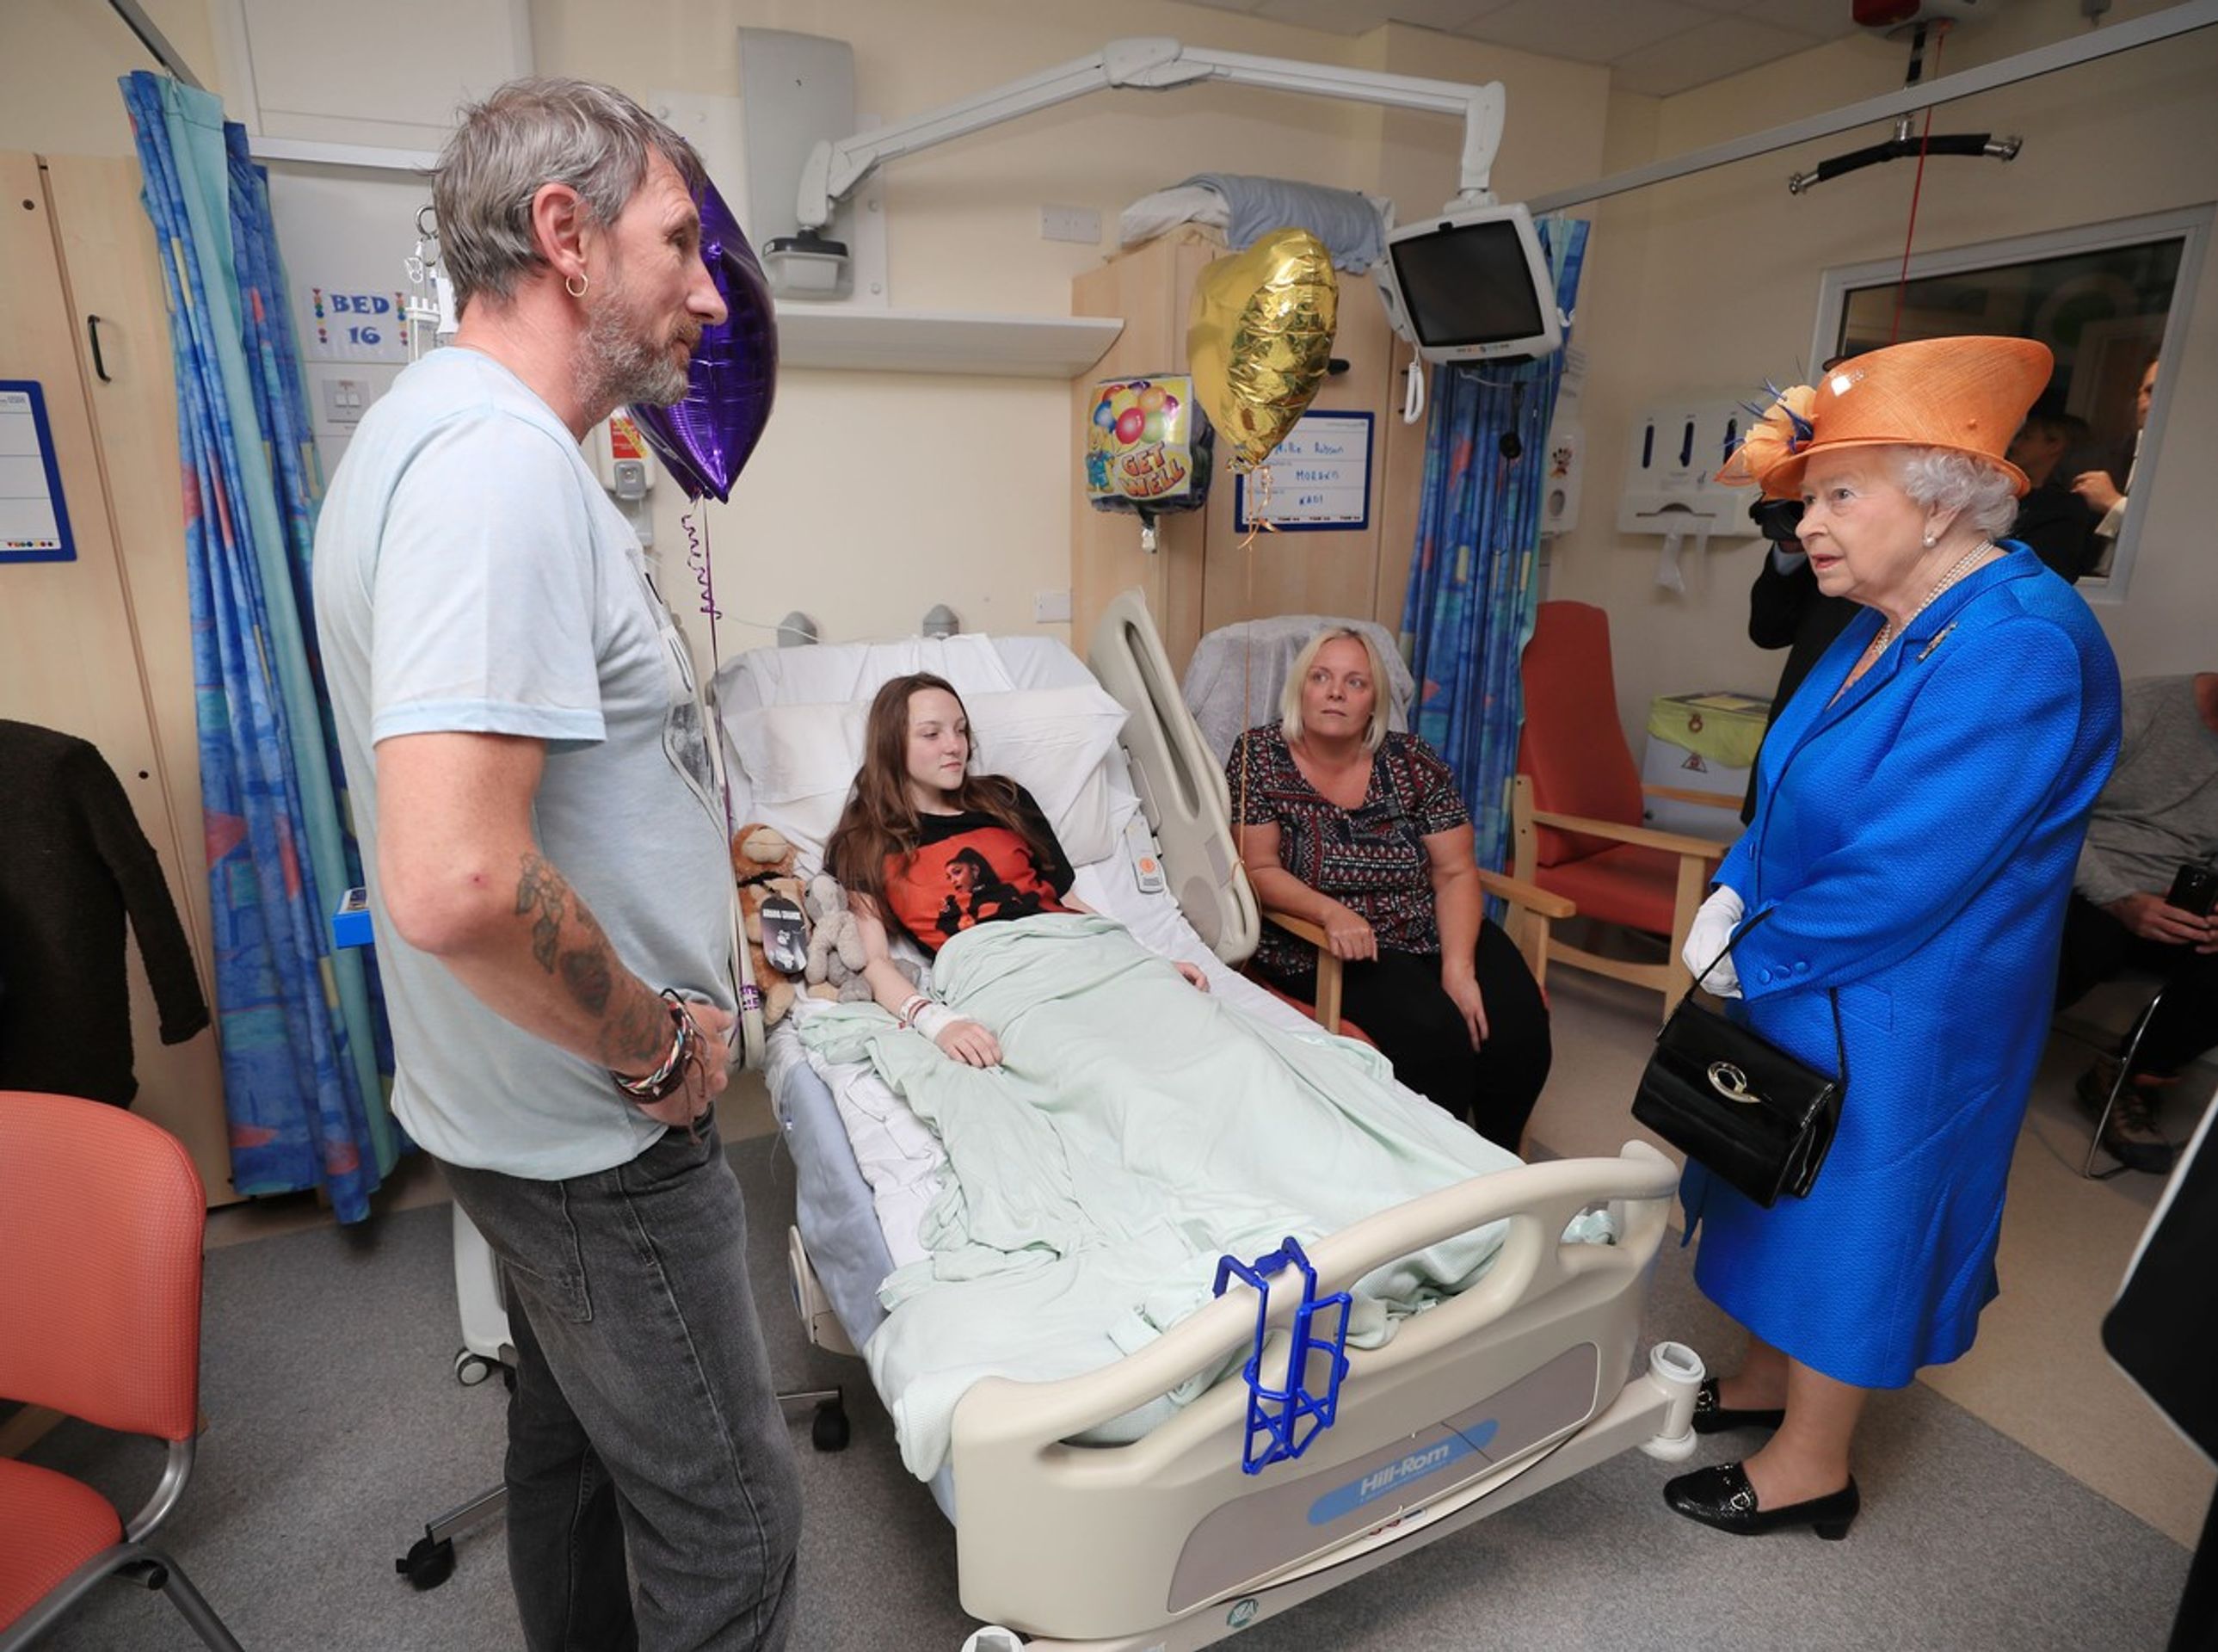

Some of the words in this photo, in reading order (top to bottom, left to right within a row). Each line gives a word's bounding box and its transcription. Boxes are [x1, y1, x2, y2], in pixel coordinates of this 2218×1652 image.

[330, 294, 391, 314] BED
[348, 326, 381, 345] 16
[1121, 440, 1165, 476] GET
[1118, 458, 1186, 497] WELL
[1360, 1446, 1450, 1495] Hill-Rom
